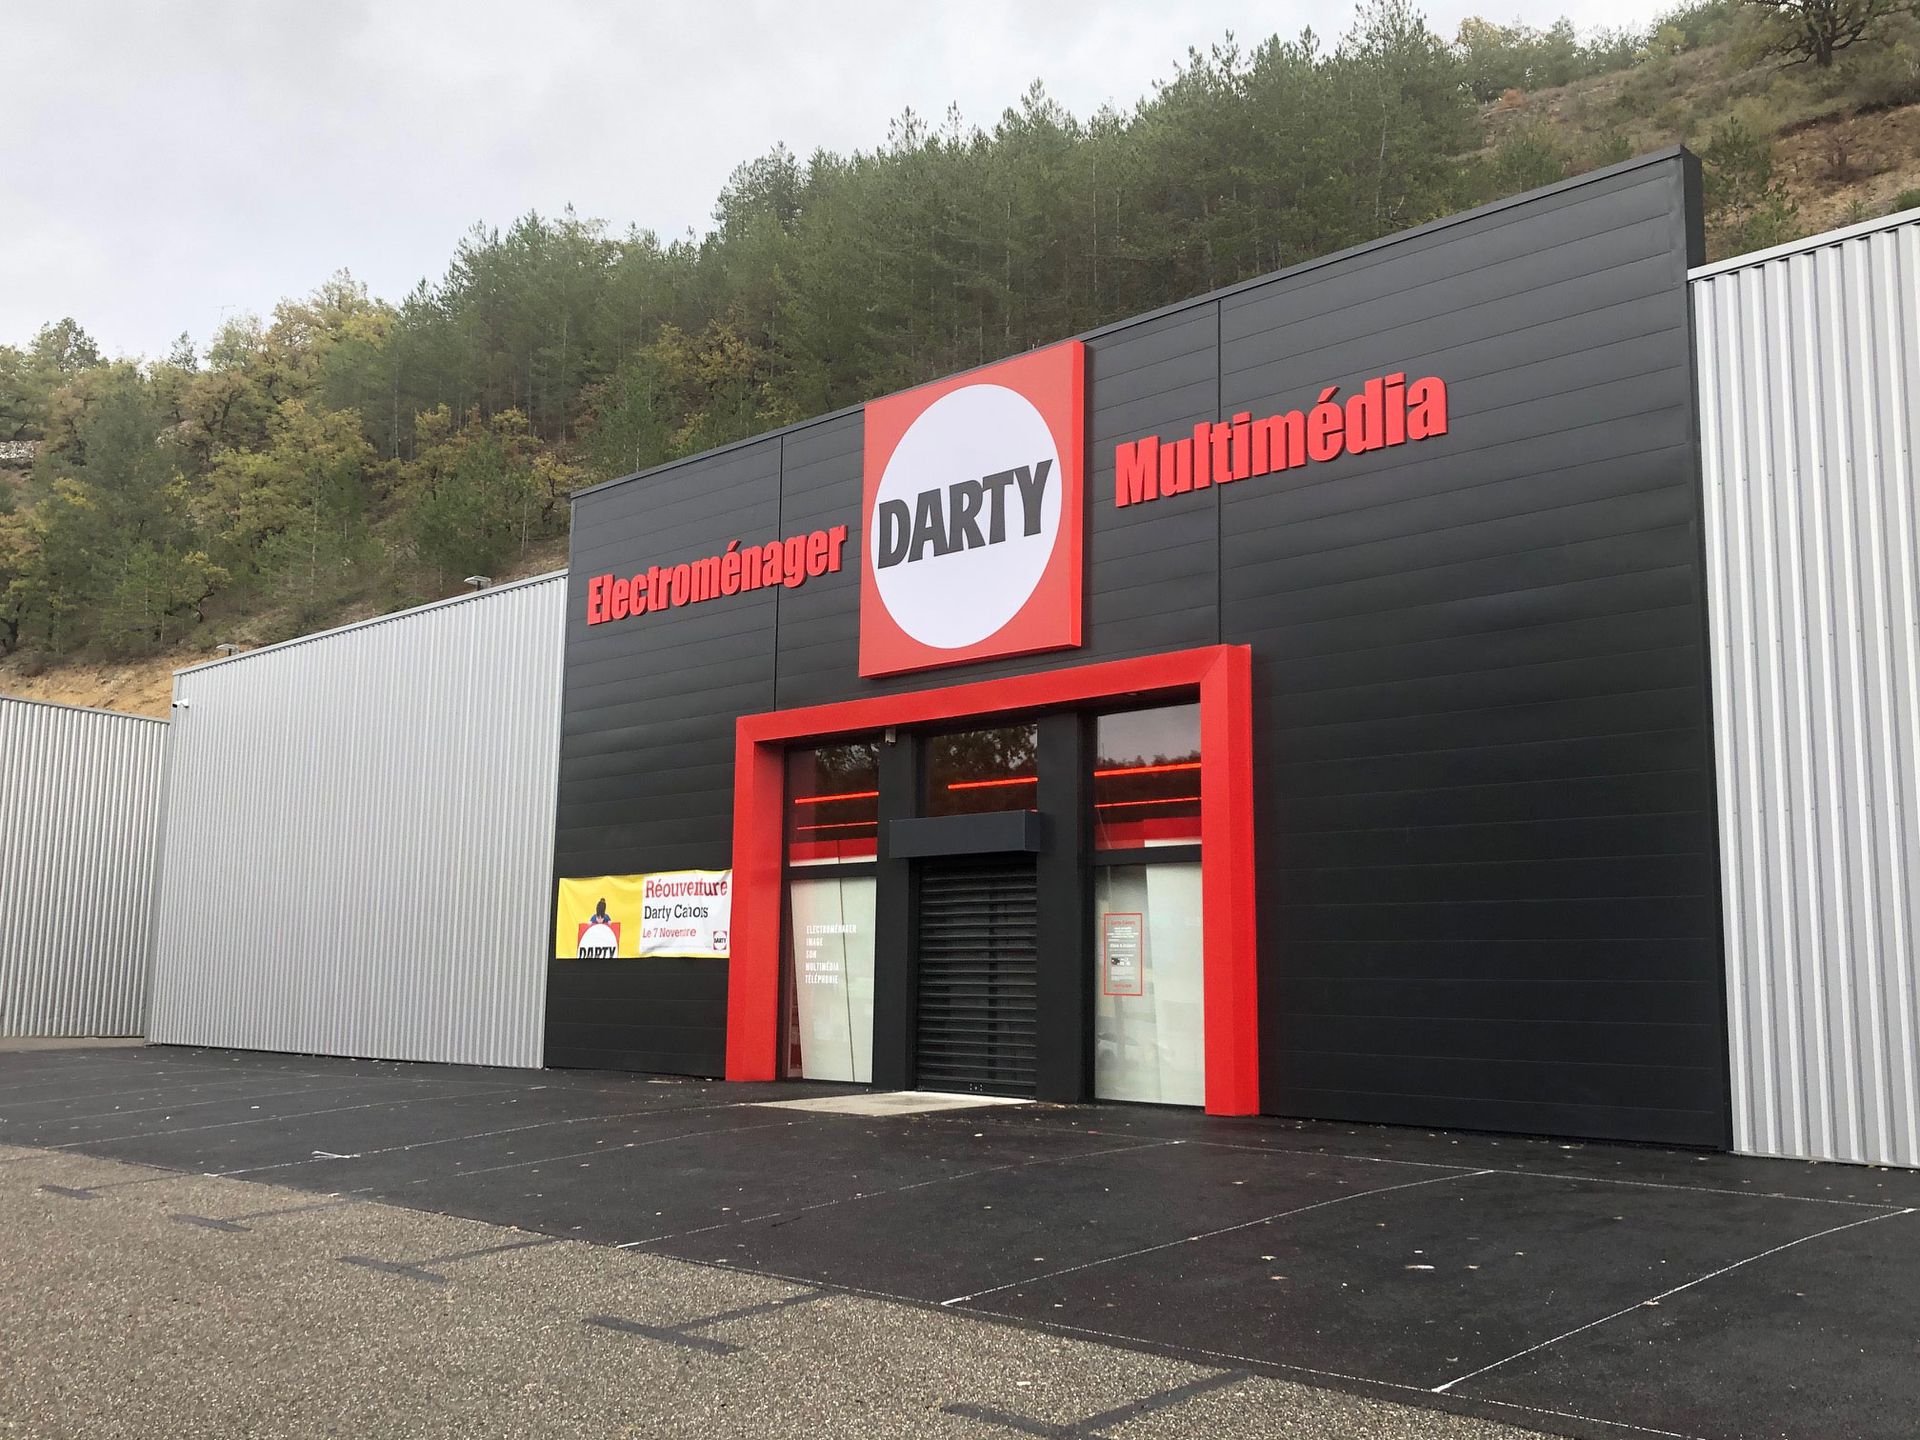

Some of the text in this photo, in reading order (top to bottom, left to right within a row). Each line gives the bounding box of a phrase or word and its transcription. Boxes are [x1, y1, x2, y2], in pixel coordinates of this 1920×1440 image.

[1115, 371, 1449, 508] Multimédia
[877, 459, 1054, 570] DARTY
[587, 524, 848, 626] Electroménager
[643, 927, 697, 938] Le 7 Novere
[644, 905, 672, 921] Darty
[578, 946, 617, 959] DARTY
